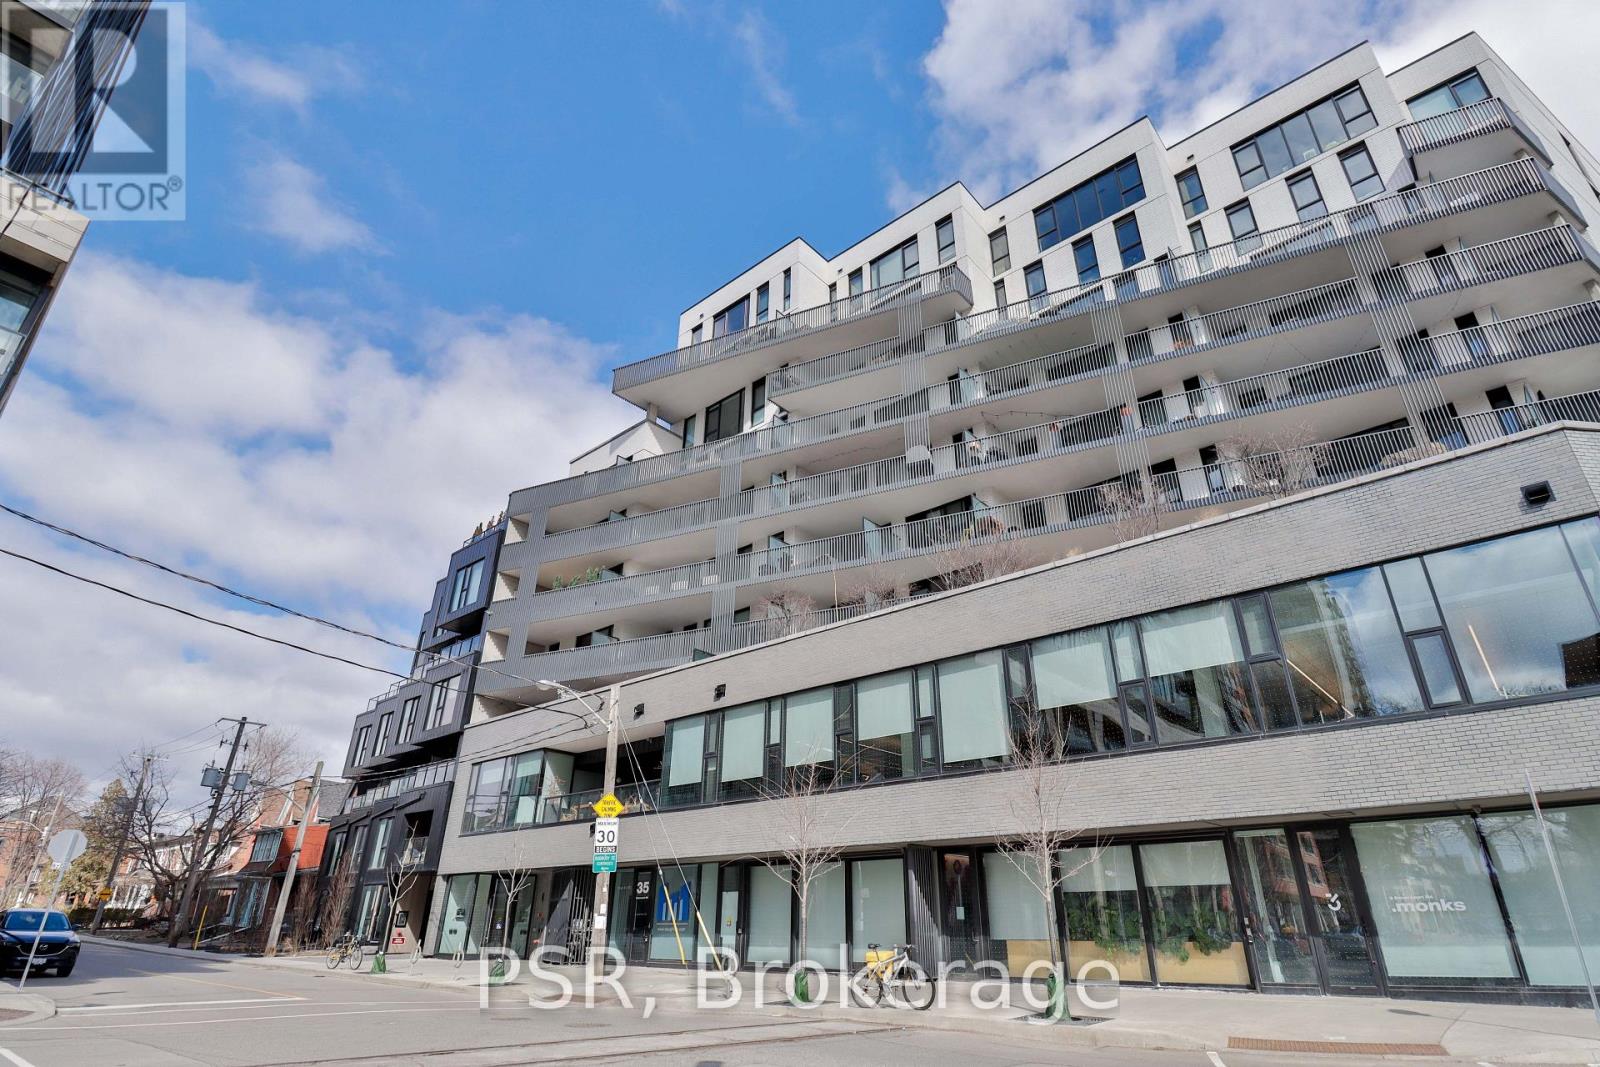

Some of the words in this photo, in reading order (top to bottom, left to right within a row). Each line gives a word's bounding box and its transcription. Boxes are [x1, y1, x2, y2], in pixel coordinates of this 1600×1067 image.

[597, 830, 615, 843] 30
[636, 881, 650, 894] 35
[1391, 898, 1467, 913] .monks
